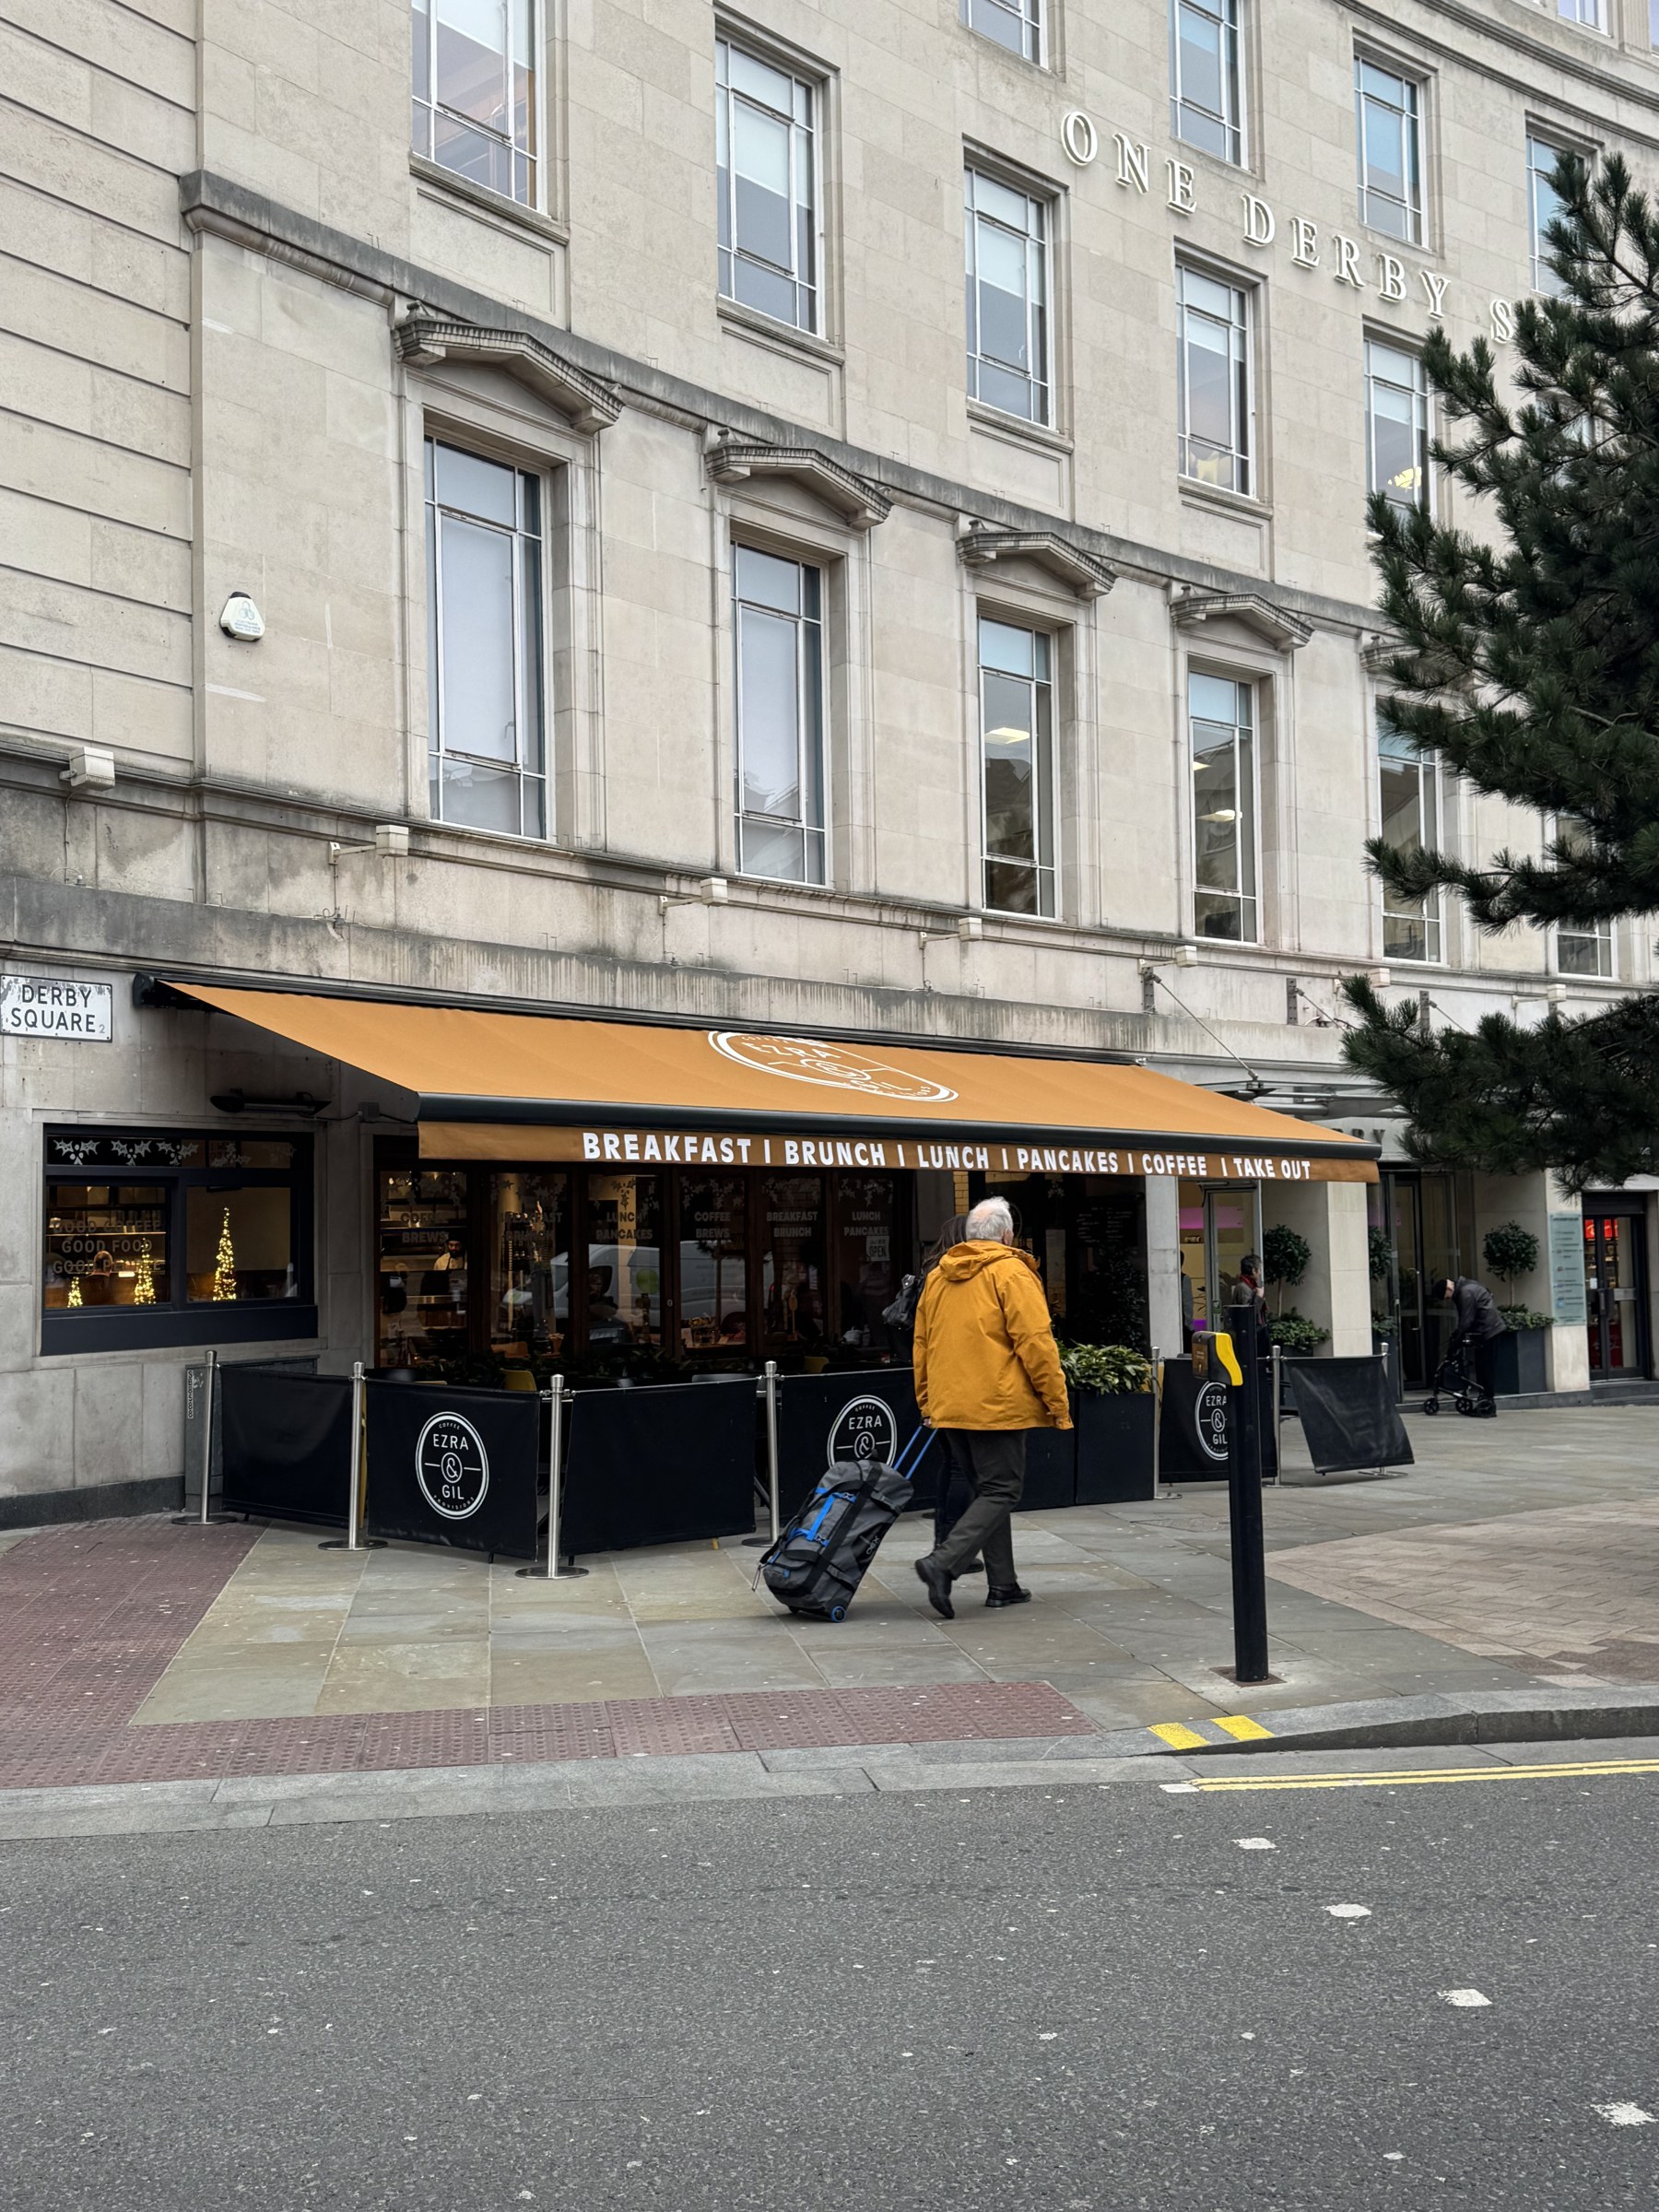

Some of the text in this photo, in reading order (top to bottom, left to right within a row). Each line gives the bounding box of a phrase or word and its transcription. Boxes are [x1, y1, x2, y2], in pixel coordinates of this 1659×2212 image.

[1061, 112, 1197, 216] ONE
[1241, 194, 1452, 321] DERBY
[22, 984, 91, 1007] DERBY
[11, 1007, 105, 1033] SQUARE 2
[741, 1041, 841, 1059] EZRA
[582, 1132, 1312, 1180] BREAKFAST BRUNCH LUNCH PANCAKES COFFEE TAKE OUT
[606, 1211, 642, 1223] LUNCH
[694, 1211, 731, 1222] COFFEE
[766, 1211, 818, 1221] BREAKFAST
[852, 1211, 881, 1221] LUNCH
[401, 1231, 449, 1243] BREWS
[595, 1229, 653, 1240] PANCAKES
[695, 1228, 731, 1239] BREWS
[773, 1227, 812, 1238] BRUNCH
[843, 1226, 889, 1237] PANCAKES
[62, 1239, 153, 1253] GOOD FOOD
[869, 1245, 887, 1258] OPEN
[53, 1259, 95, 1275] GOOD
[1206, 1394, 1228, 1407] EZRA
[848, 1415, 883, 1430] EZRA
[432, 1433, 469, 1451] EZRA
[1212, 1433, 1229, 1445] GIL
[446, 1457, 458, 1478] &
[441, 1484, 465, 1500] GIL
